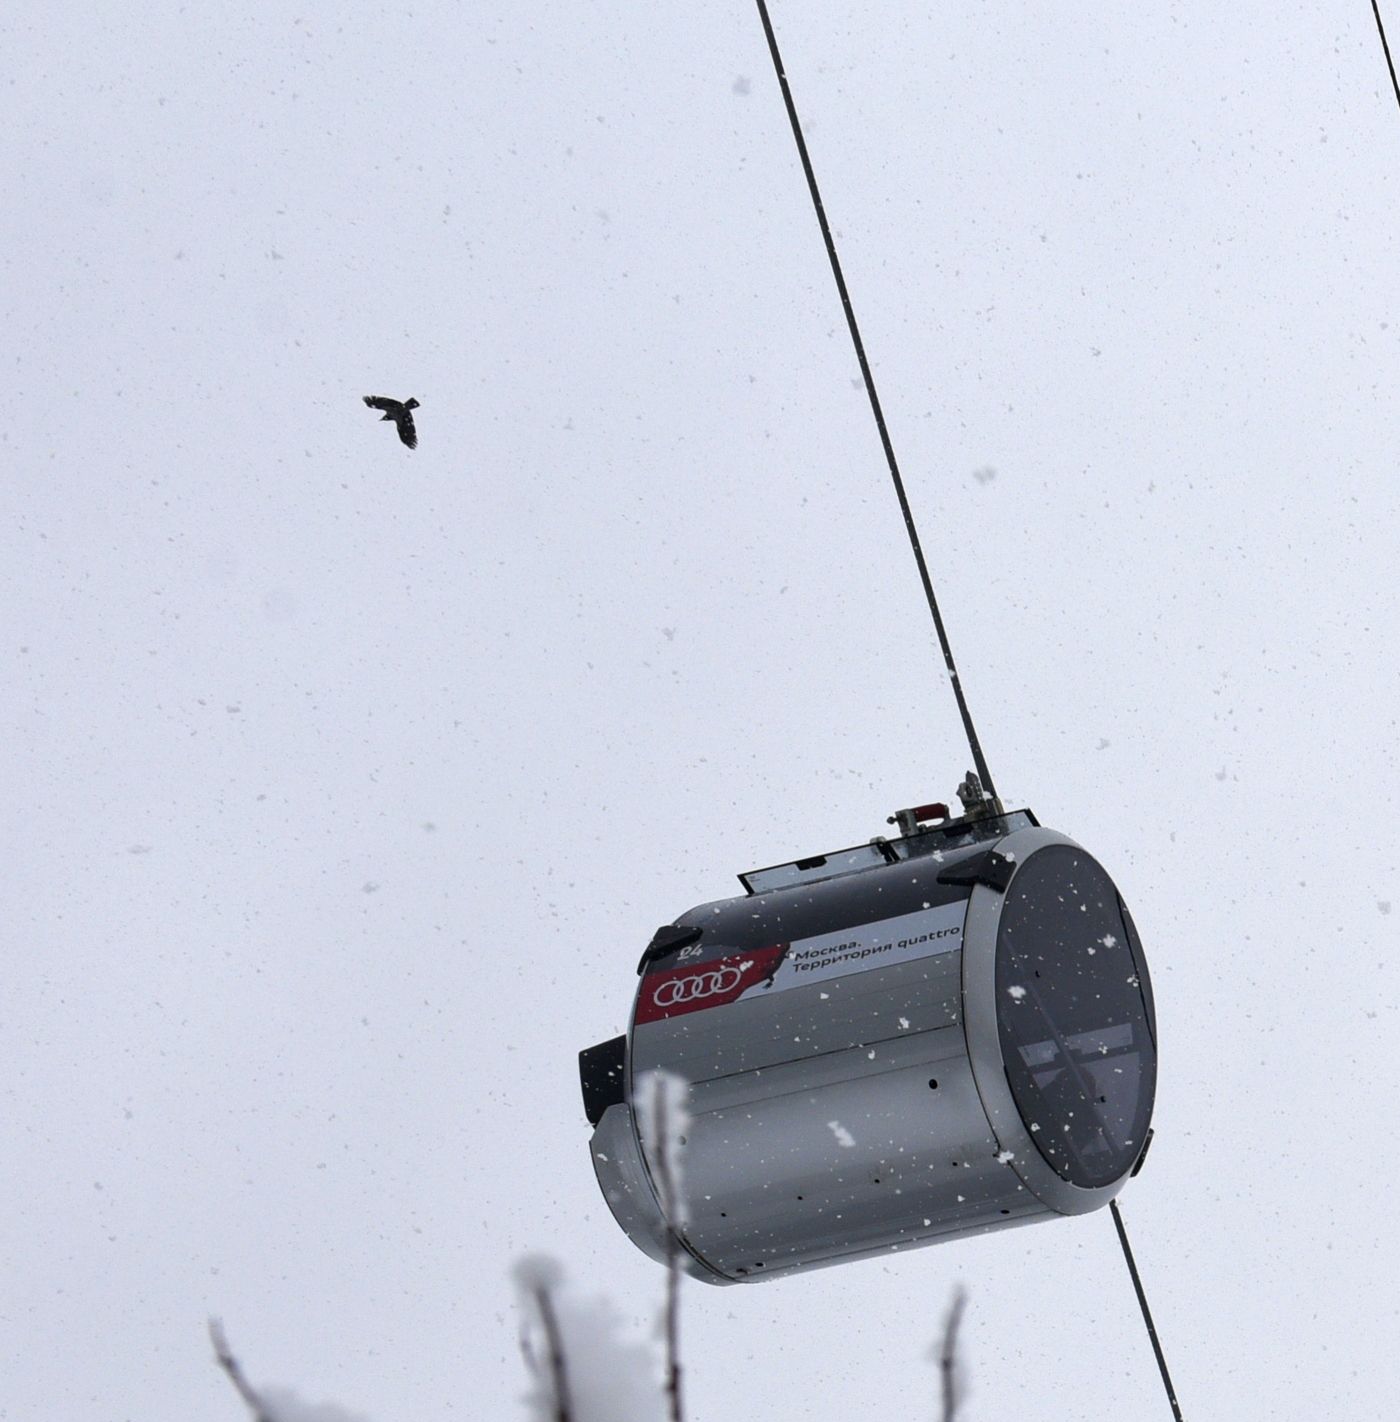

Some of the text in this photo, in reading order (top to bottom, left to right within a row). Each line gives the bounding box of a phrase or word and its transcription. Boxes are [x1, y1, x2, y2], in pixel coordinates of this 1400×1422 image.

[792, 926, 960, 973] Территория quattro
[794, 941, 862, 962] Москва.
